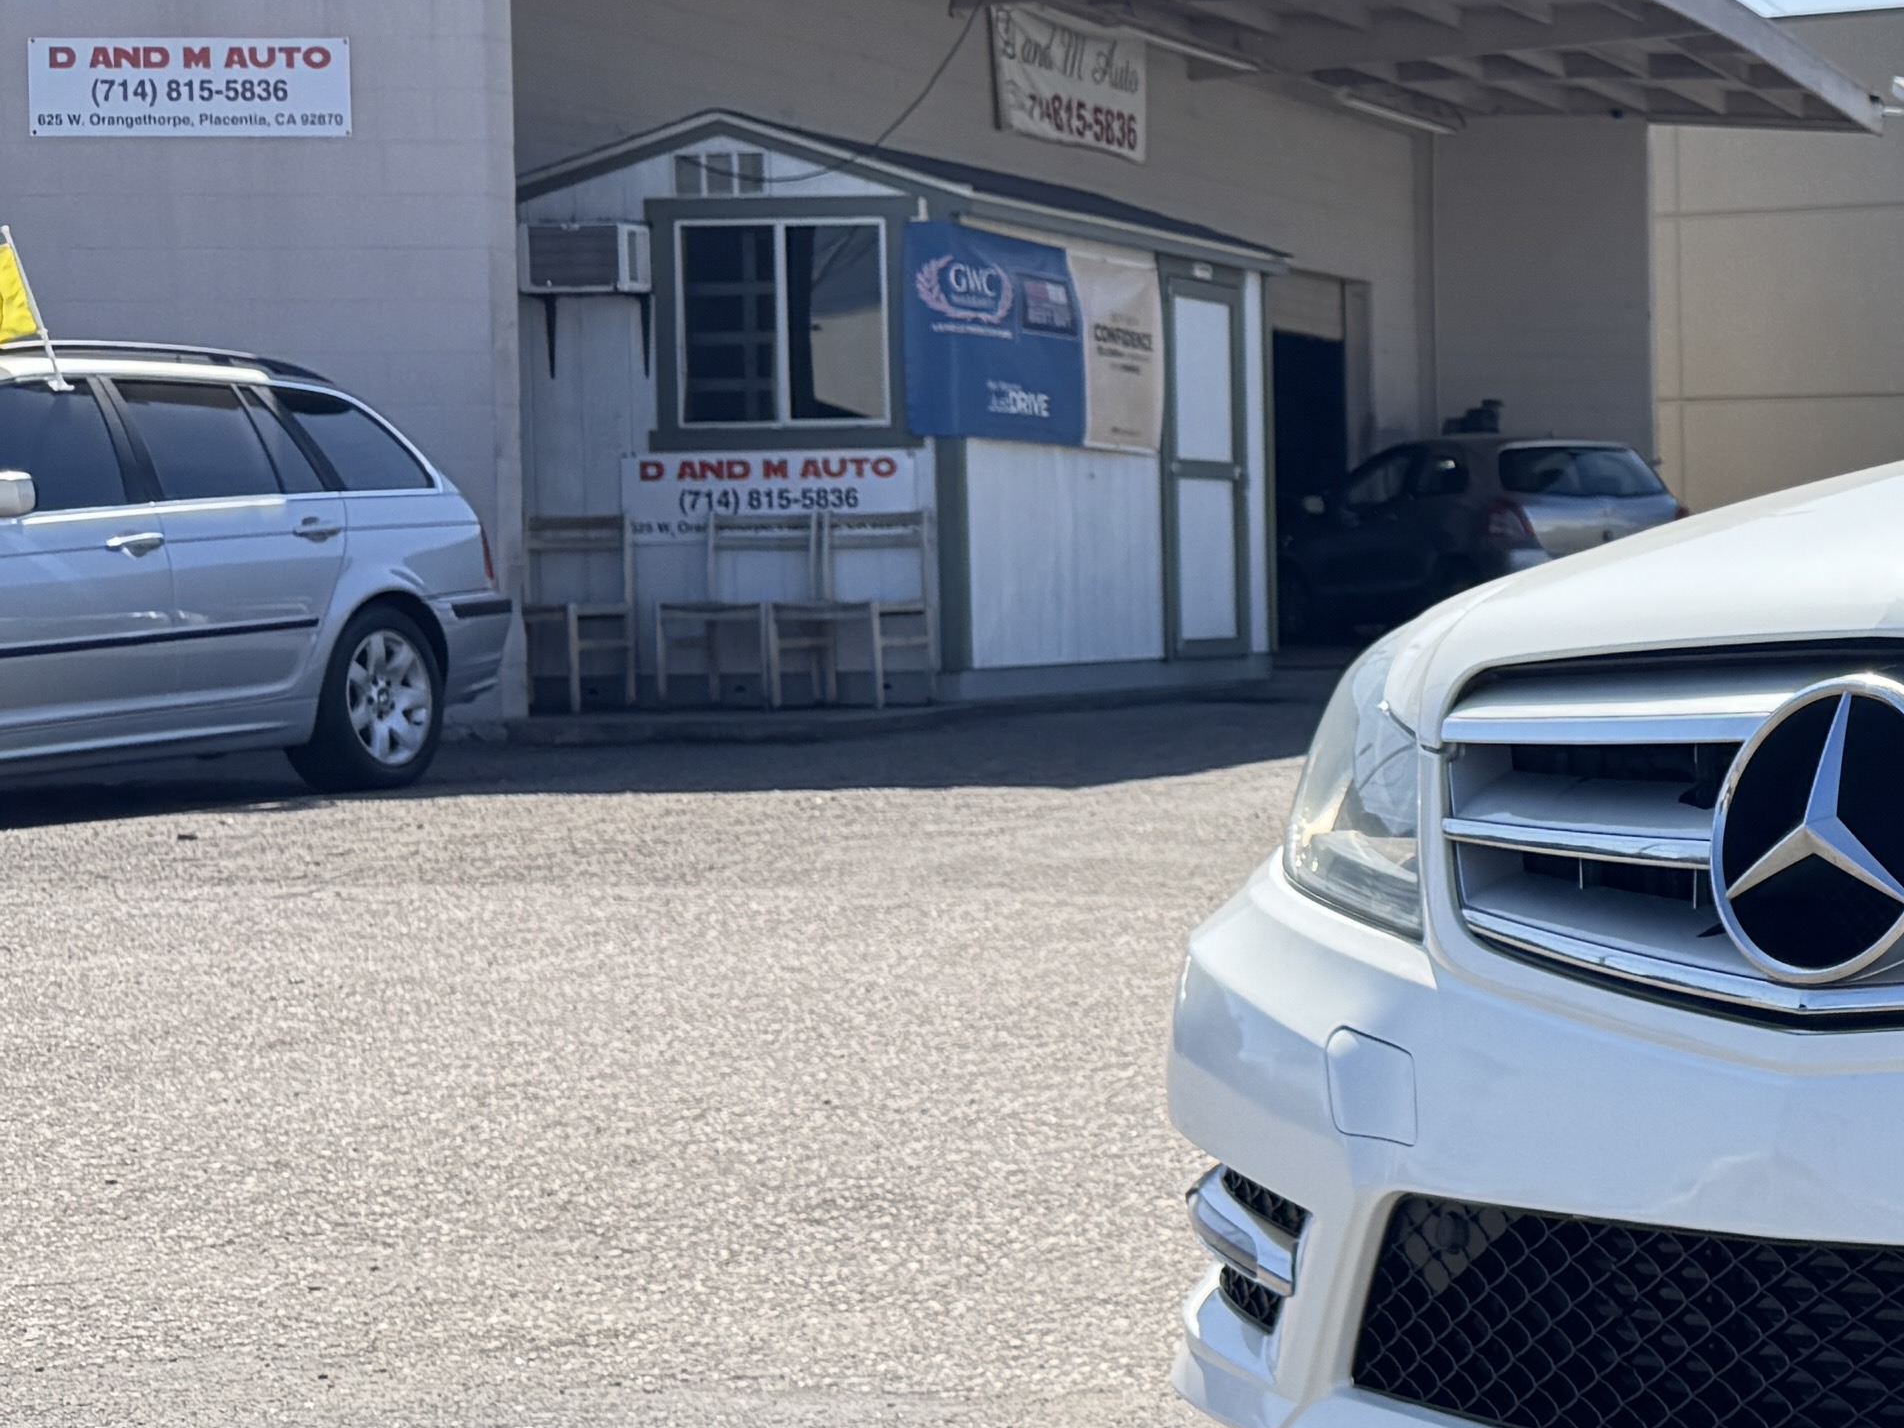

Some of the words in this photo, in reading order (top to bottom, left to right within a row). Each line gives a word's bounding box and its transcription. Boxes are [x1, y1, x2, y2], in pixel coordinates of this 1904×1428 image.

[49, 46, 77, 69] D
[89, 46, 170, 69] AND
[182, 46, 212, 69] M
[224, 46, 332, 70] AUTO
[1092, 39, 1139, 94] Auto
[91, 78, 158, 108] (714)
[166, 78, 289, 103] 815-5836
[275, 113, 297, 126] CA
[949, 263, 998, 298] GWC
[639, 460, 665, 482] D
[677, 459, 752, 481] AND
[762, 458, 789, 480] M
[800, 456, 898, 478] AUTO
[679, 487, 740, 515] (714)
[748, 487, 859, 510] 815-5836
